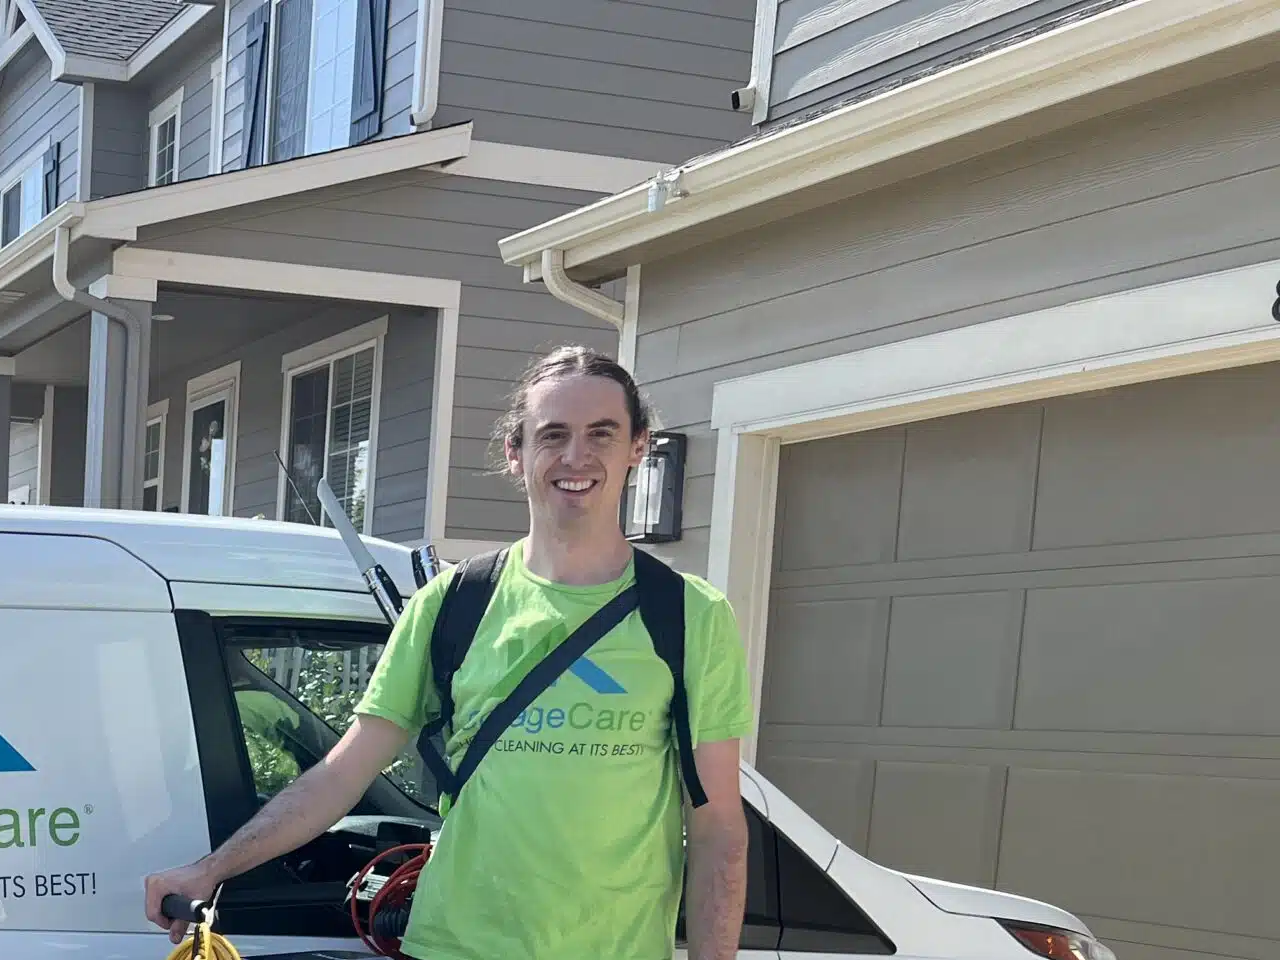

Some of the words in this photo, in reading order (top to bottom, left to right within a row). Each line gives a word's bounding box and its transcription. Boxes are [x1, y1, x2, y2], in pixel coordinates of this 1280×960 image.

[493, 739, 565, 755] CLEANING
[568, 742, 589, 757] AT
[589, 742, 609, 757] ITS
[35, 872, 97, 897] BEST!
